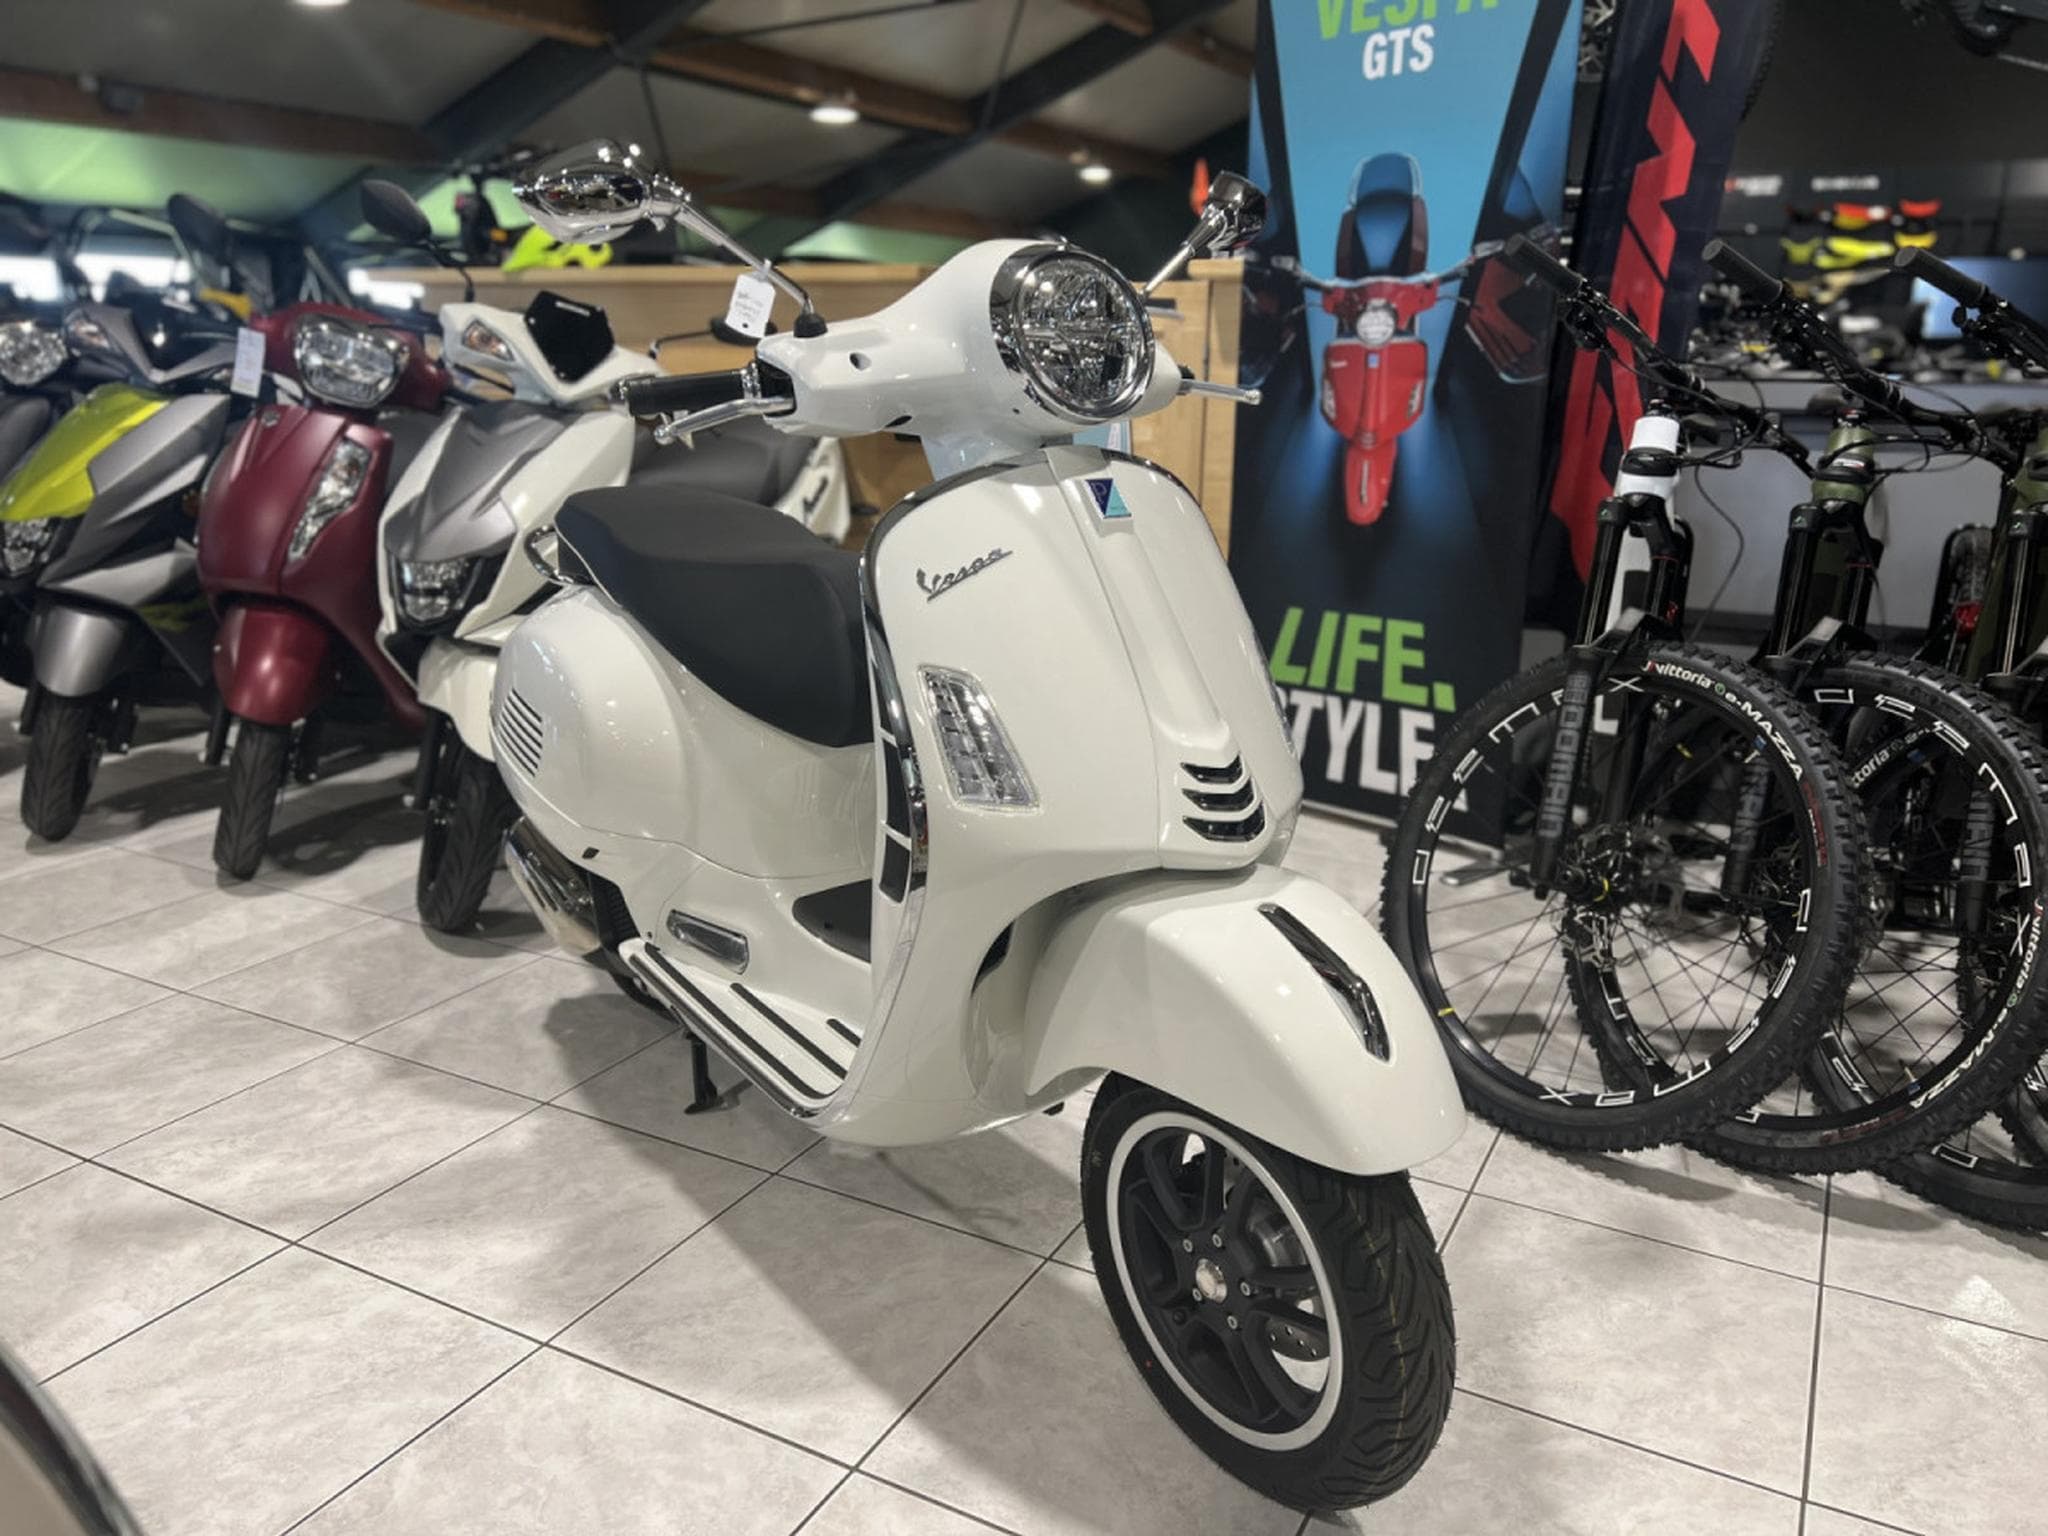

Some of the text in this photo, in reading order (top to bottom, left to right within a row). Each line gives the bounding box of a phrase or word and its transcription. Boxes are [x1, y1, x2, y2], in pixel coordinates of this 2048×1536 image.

[1362, 24, 1436, 81] GTS
[915, 546, 1013, 603] Vespa
[1269, 607, 1457, 713] LIFE.
[1654, 662, 1713, 690] vittoria
[1724, 691, 1804, 781] e-MAZZA
